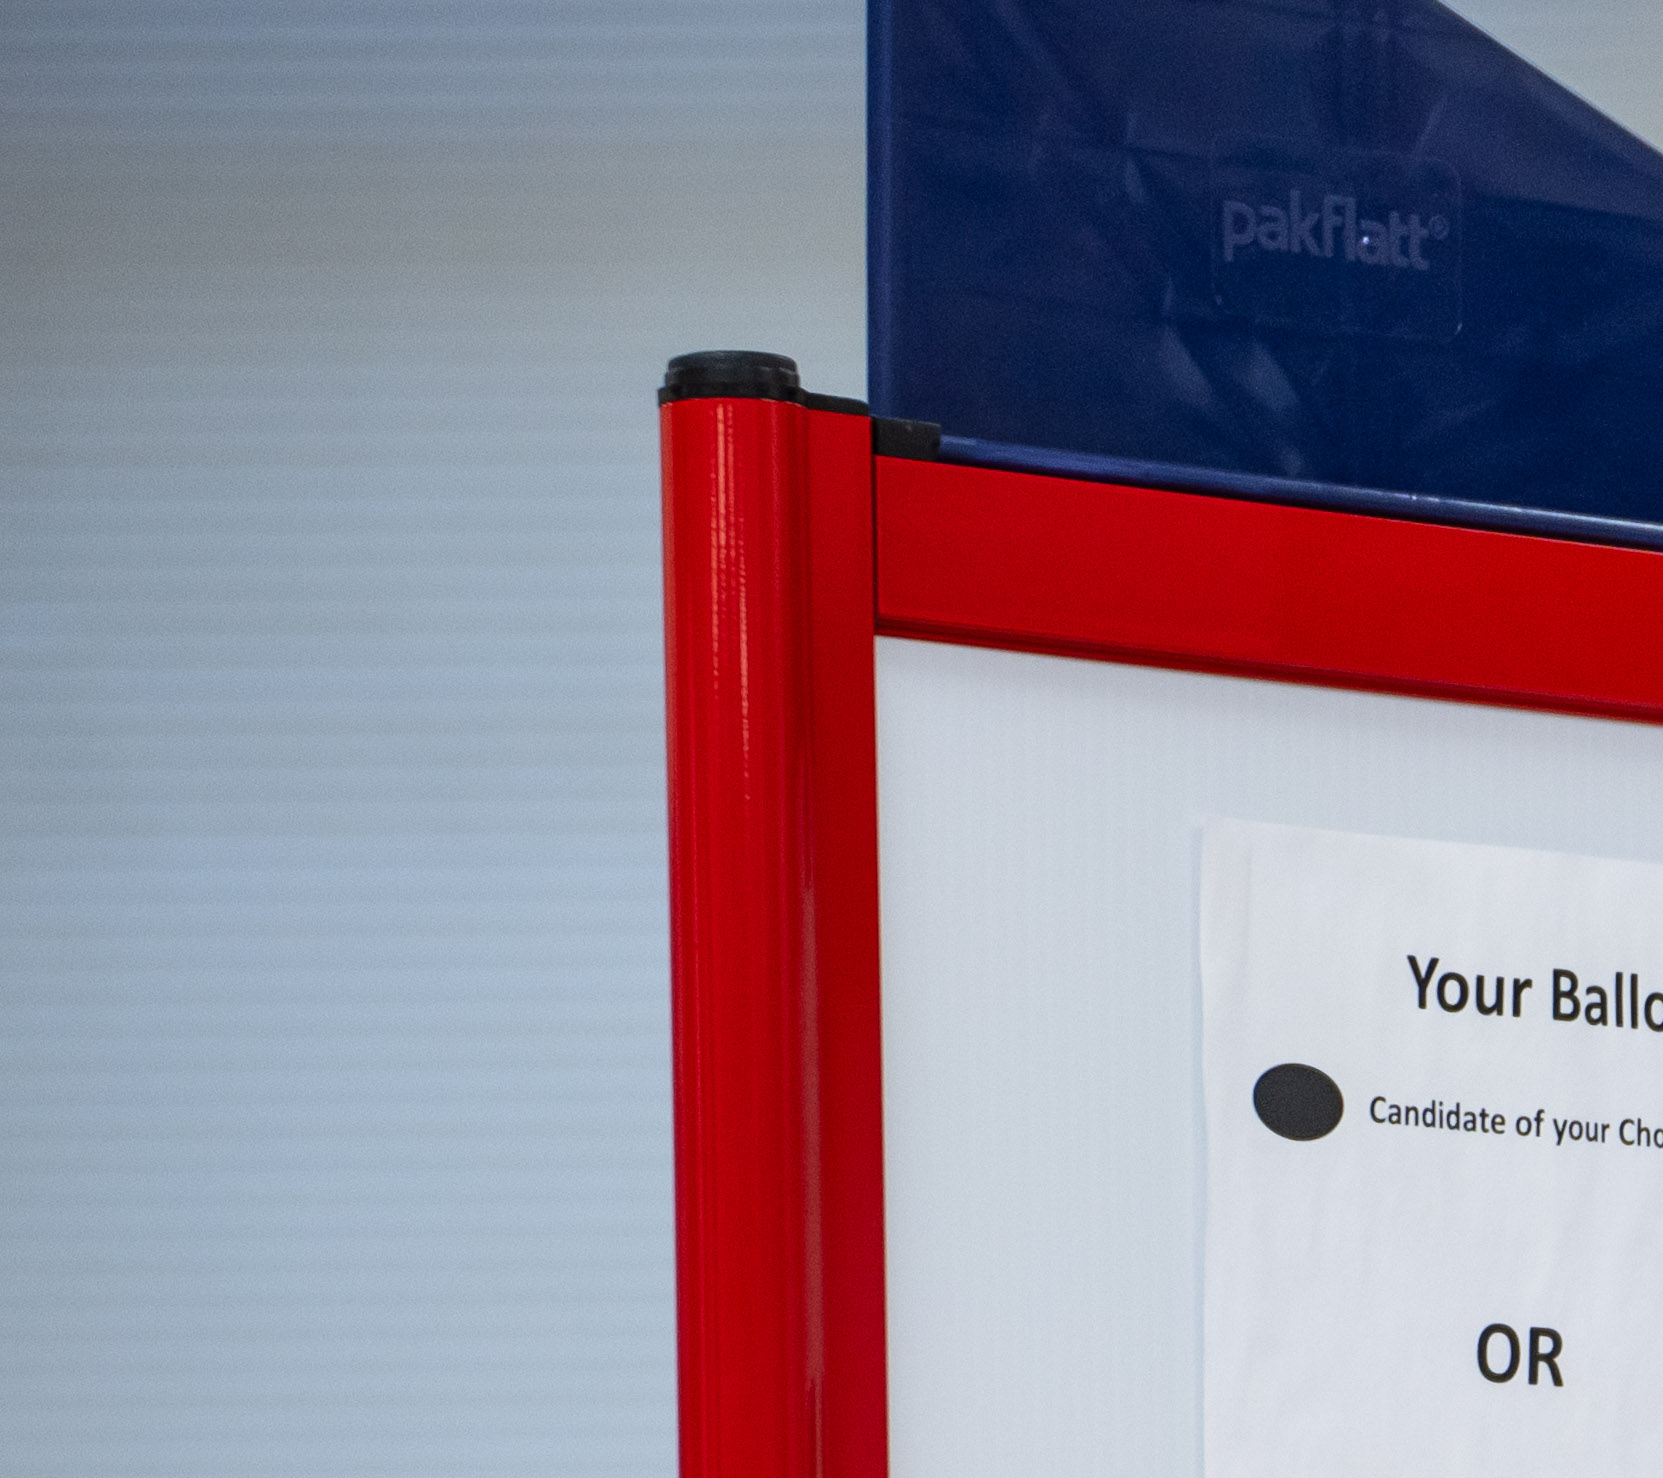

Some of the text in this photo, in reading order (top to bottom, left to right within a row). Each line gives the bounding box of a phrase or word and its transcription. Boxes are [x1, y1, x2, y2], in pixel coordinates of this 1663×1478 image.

[1406, 954, 1533, 1018] Your
[1369, 1095, 1506, 1135] Candidate
[1515, 1108, 1546, 1138] of
[1552, 1118, 1611, 1147] your
[1476, 1322, 1564, 1388] OR
